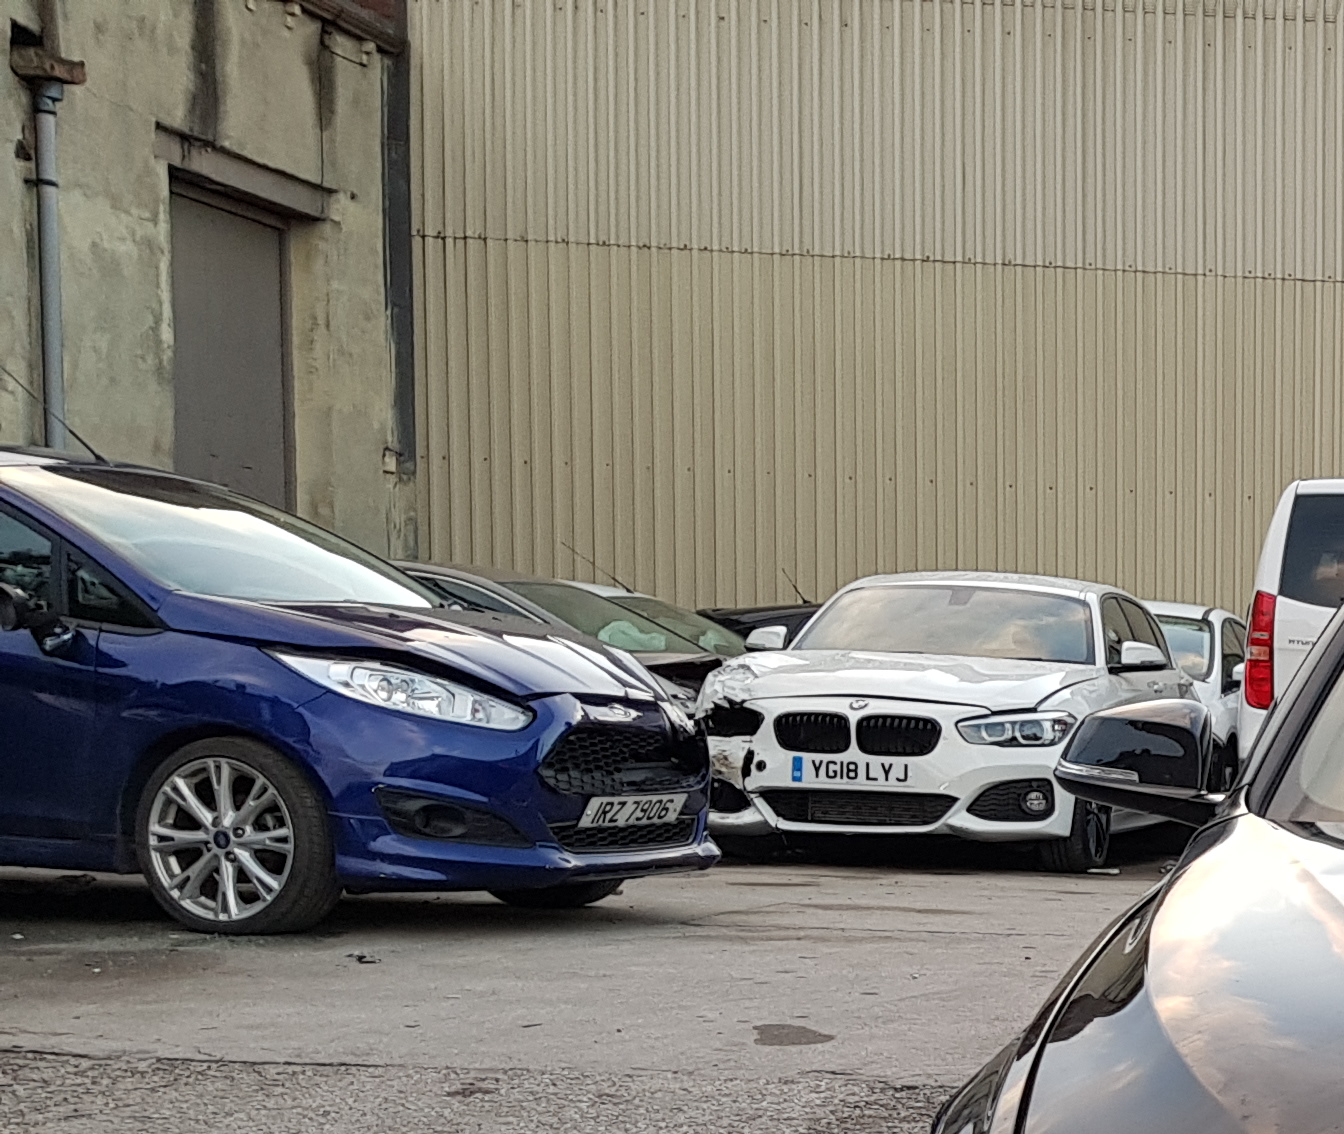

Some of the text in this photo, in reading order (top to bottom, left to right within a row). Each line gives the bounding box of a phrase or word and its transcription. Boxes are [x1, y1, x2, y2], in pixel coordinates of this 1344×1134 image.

[812, 760, 909, 782] YG18 LYJ
[591, 799, 674, 824] IRZ 7906
